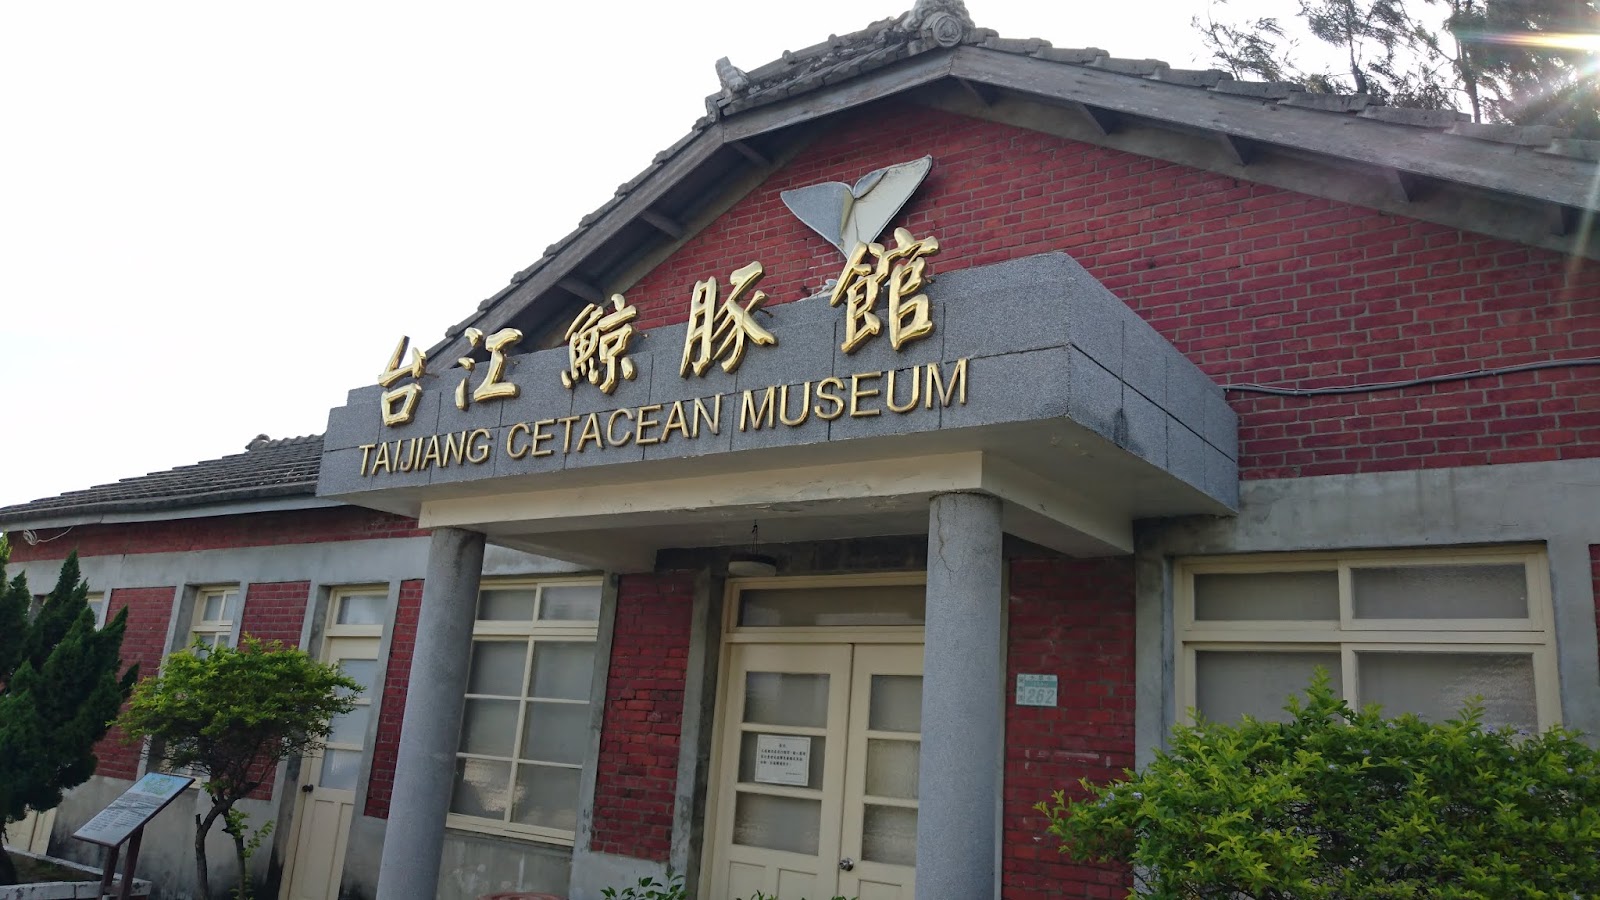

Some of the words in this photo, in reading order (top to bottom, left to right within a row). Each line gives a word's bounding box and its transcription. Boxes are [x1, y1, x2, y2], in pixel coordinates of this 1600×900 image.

[378, 227, 939, 426] 台江鯨豚館
[358, 427, 493, 476] TAIJIANG
[506, 393, 722, 461] CETACEAN
[739, 358, 969, 431] MUSEUM
[1025, 688, 1055, 704] 262
